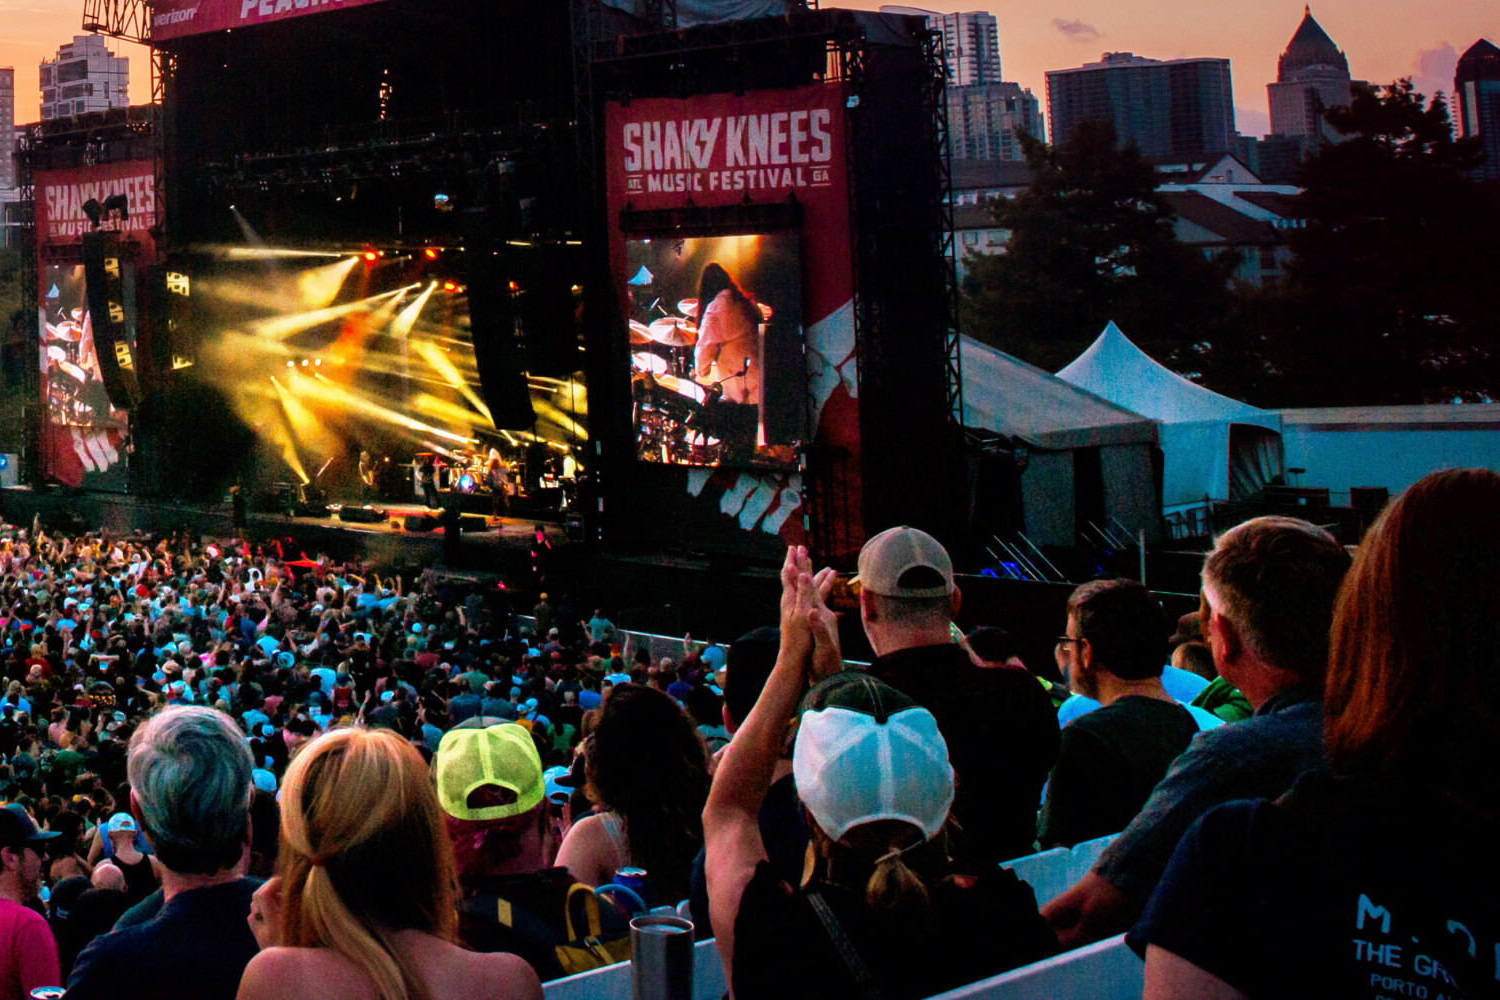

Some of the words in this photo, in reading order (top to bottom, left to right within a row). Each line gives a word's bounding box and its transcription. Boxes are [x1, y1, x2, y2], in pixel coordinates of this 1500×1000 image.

[623, 117, 722, 173] SHAKY
[726, 108, 832, 168] KNEES
[647, 173, 703, 193] MUSIC
[710, 168, 807, 190] FESTIVAL
[812, 170, 830, 182] GA
[1351, 938, 1404, 969] THE
[1369, 972, 1429, 1000] PORTO
